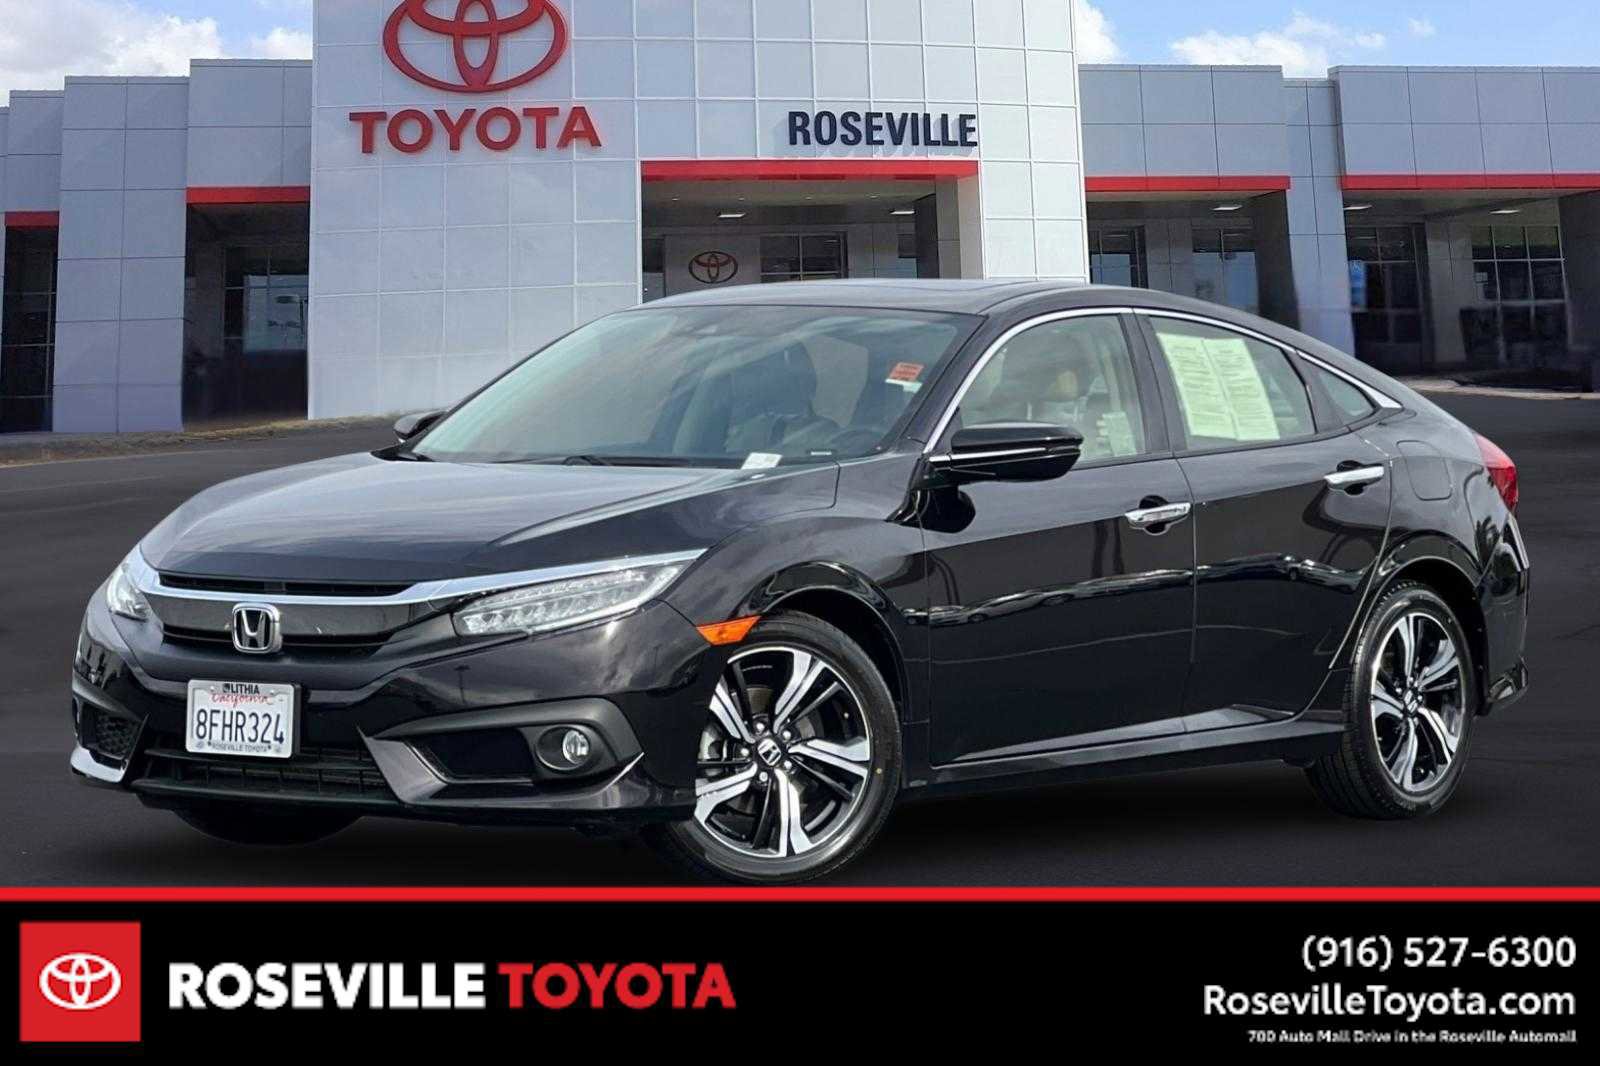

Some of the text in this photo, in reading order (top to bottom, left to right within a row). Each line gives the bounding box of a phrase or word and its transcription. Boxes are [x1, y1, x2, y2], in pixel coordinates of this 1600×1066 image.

[349, 106, 602, 154] TOYOTA
[788, 111, 978, 147] ROSEVILLE
[230, 683, 260, 694] LITHIA
[196, 708, 285, 744] 8FHR324
[212, 743, 242, 752] ROSEVILLE
